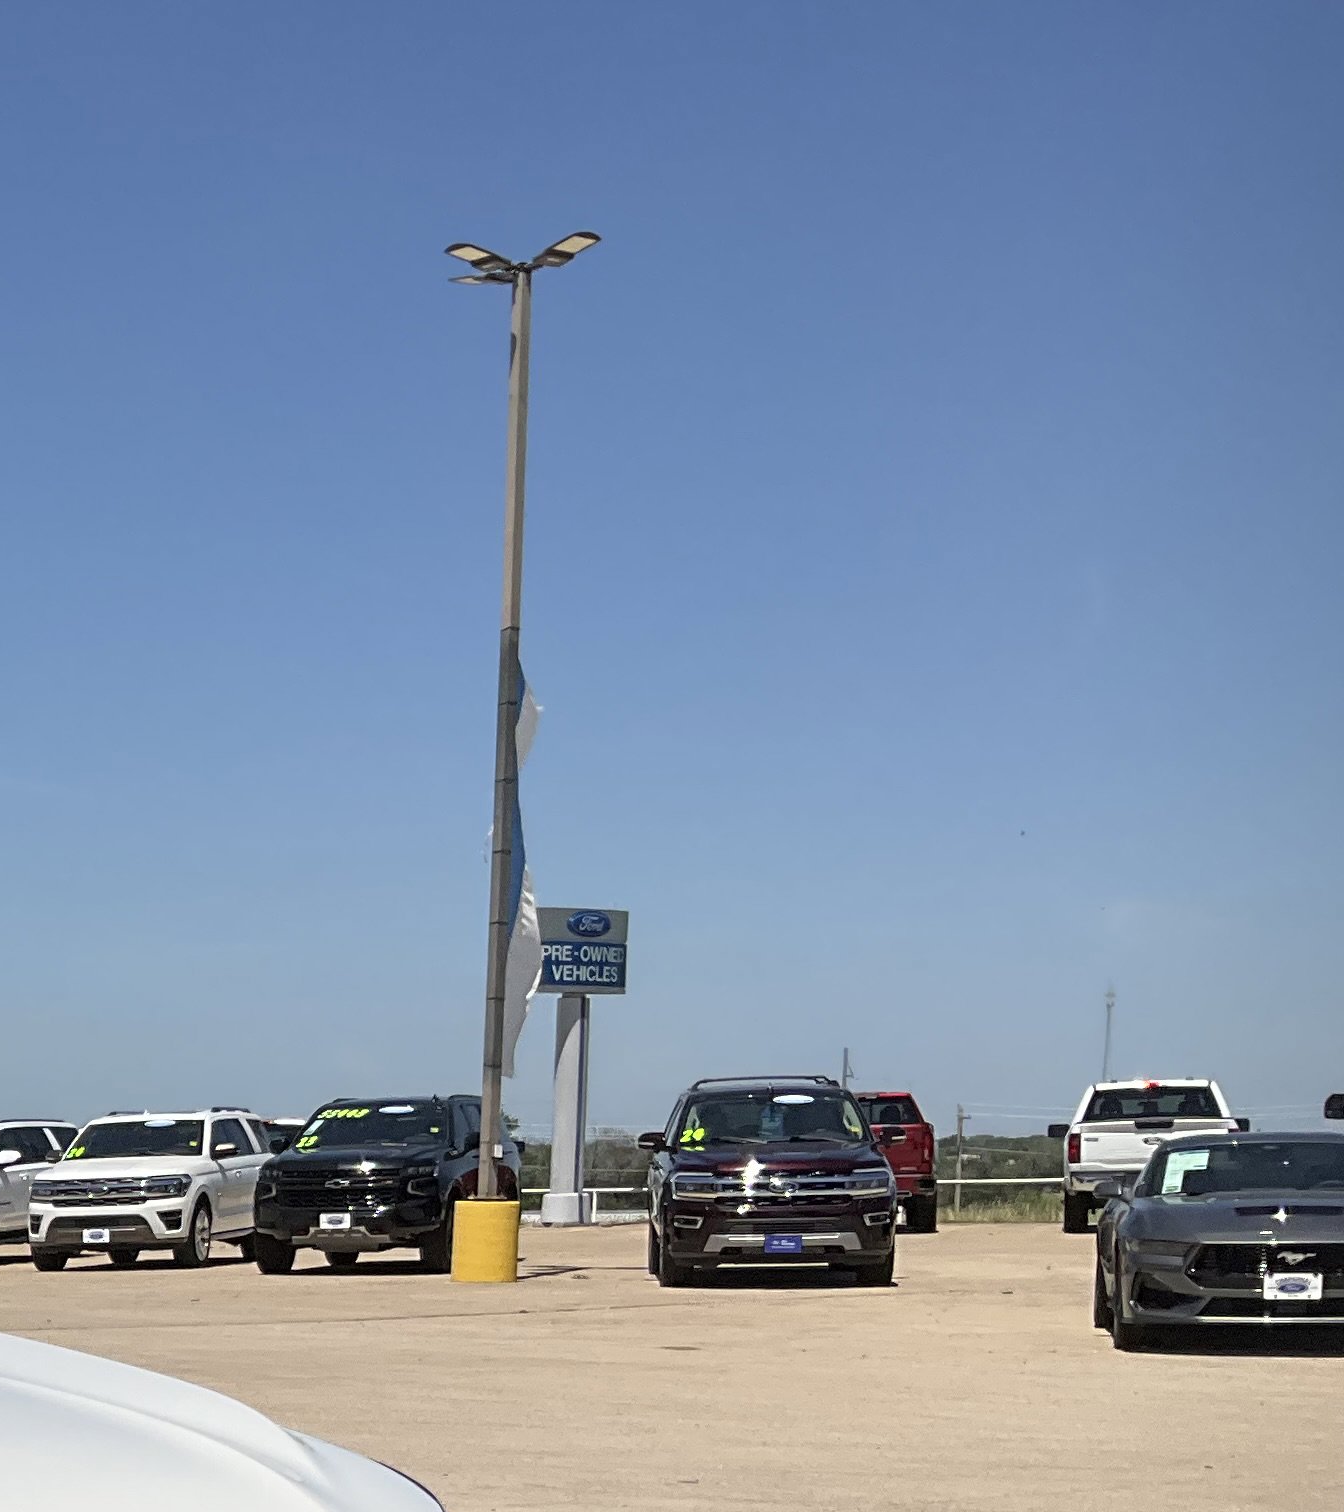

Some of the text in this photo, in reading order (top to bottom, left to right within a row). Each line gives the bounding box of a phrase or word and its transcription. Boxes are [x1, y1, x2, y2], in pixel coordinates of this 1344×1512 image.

[579, 915, 606, 932] Ford
[542, 944, 625, 963] PRE-OWNED
[552, 964, 618, 983] VEHICLES
